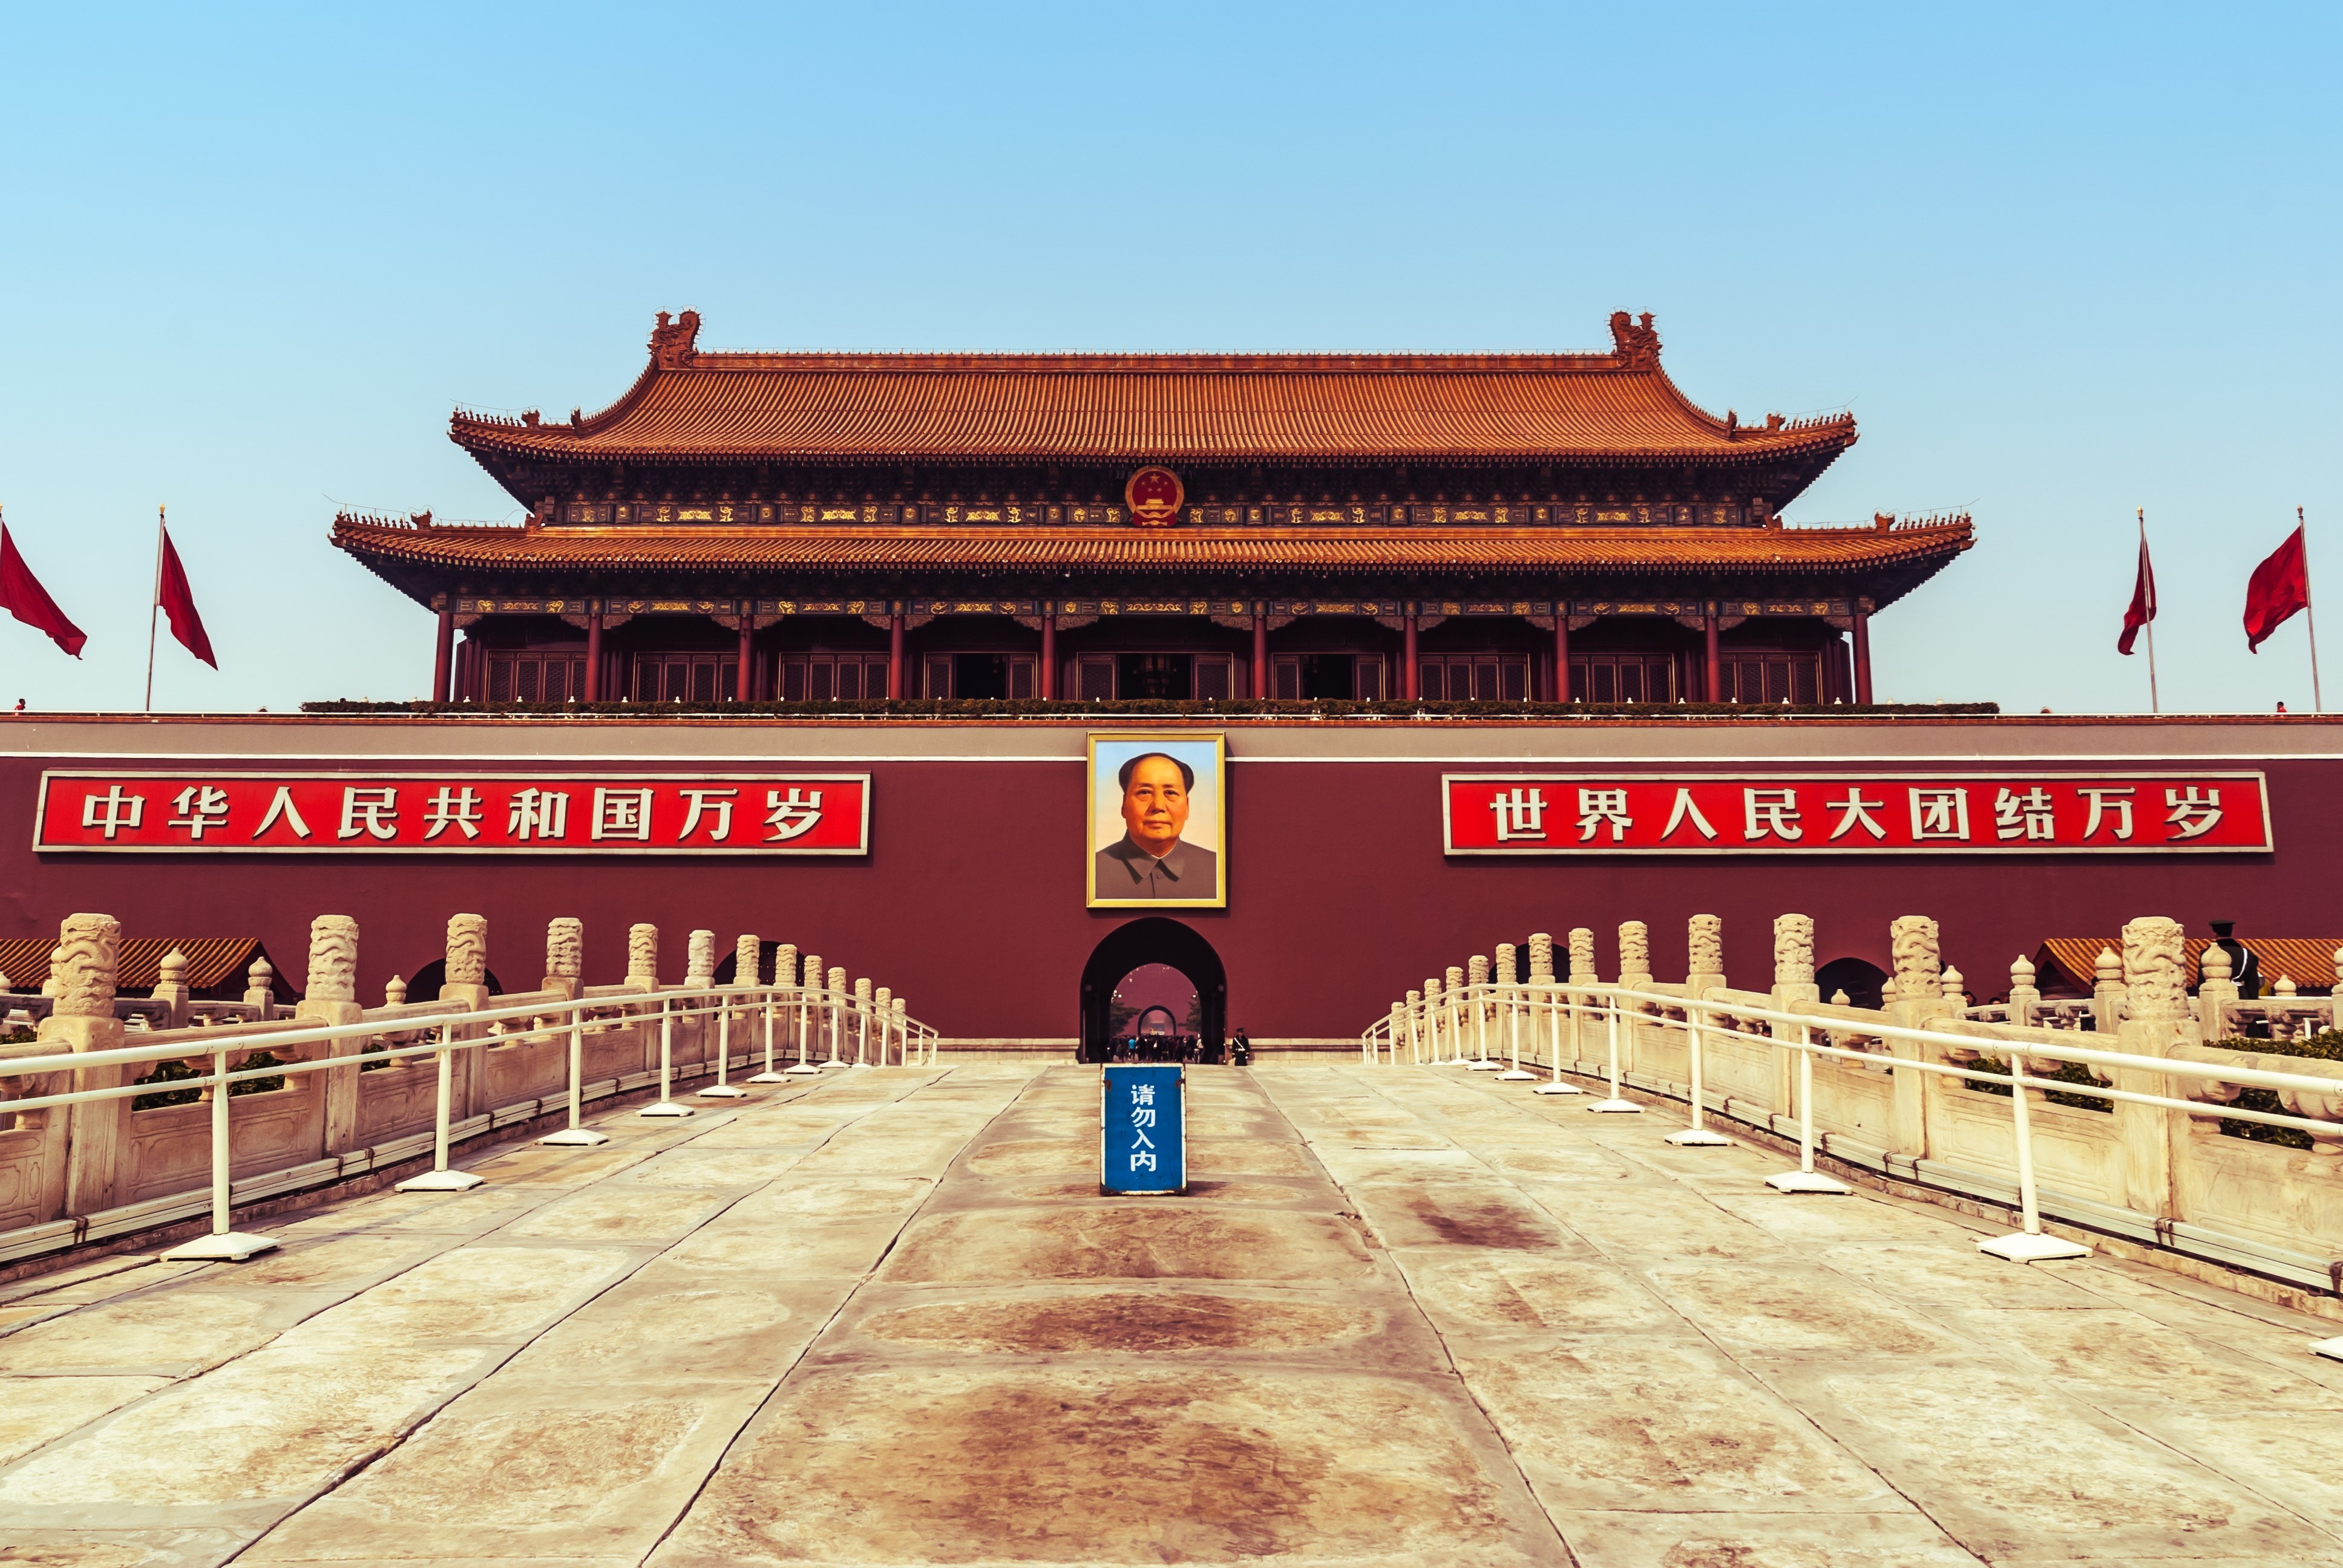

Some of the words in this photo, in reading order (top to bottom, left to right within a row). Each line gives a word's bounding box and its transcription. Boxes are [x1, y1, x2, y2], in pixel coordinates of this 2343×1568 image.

[82, 785, 822, 841] 中华人民共和国万岁
[1489, 786, 2223, 841] 世界人民大团结万岁
[1130, 1084, 1156, 1172] 请勿入内
